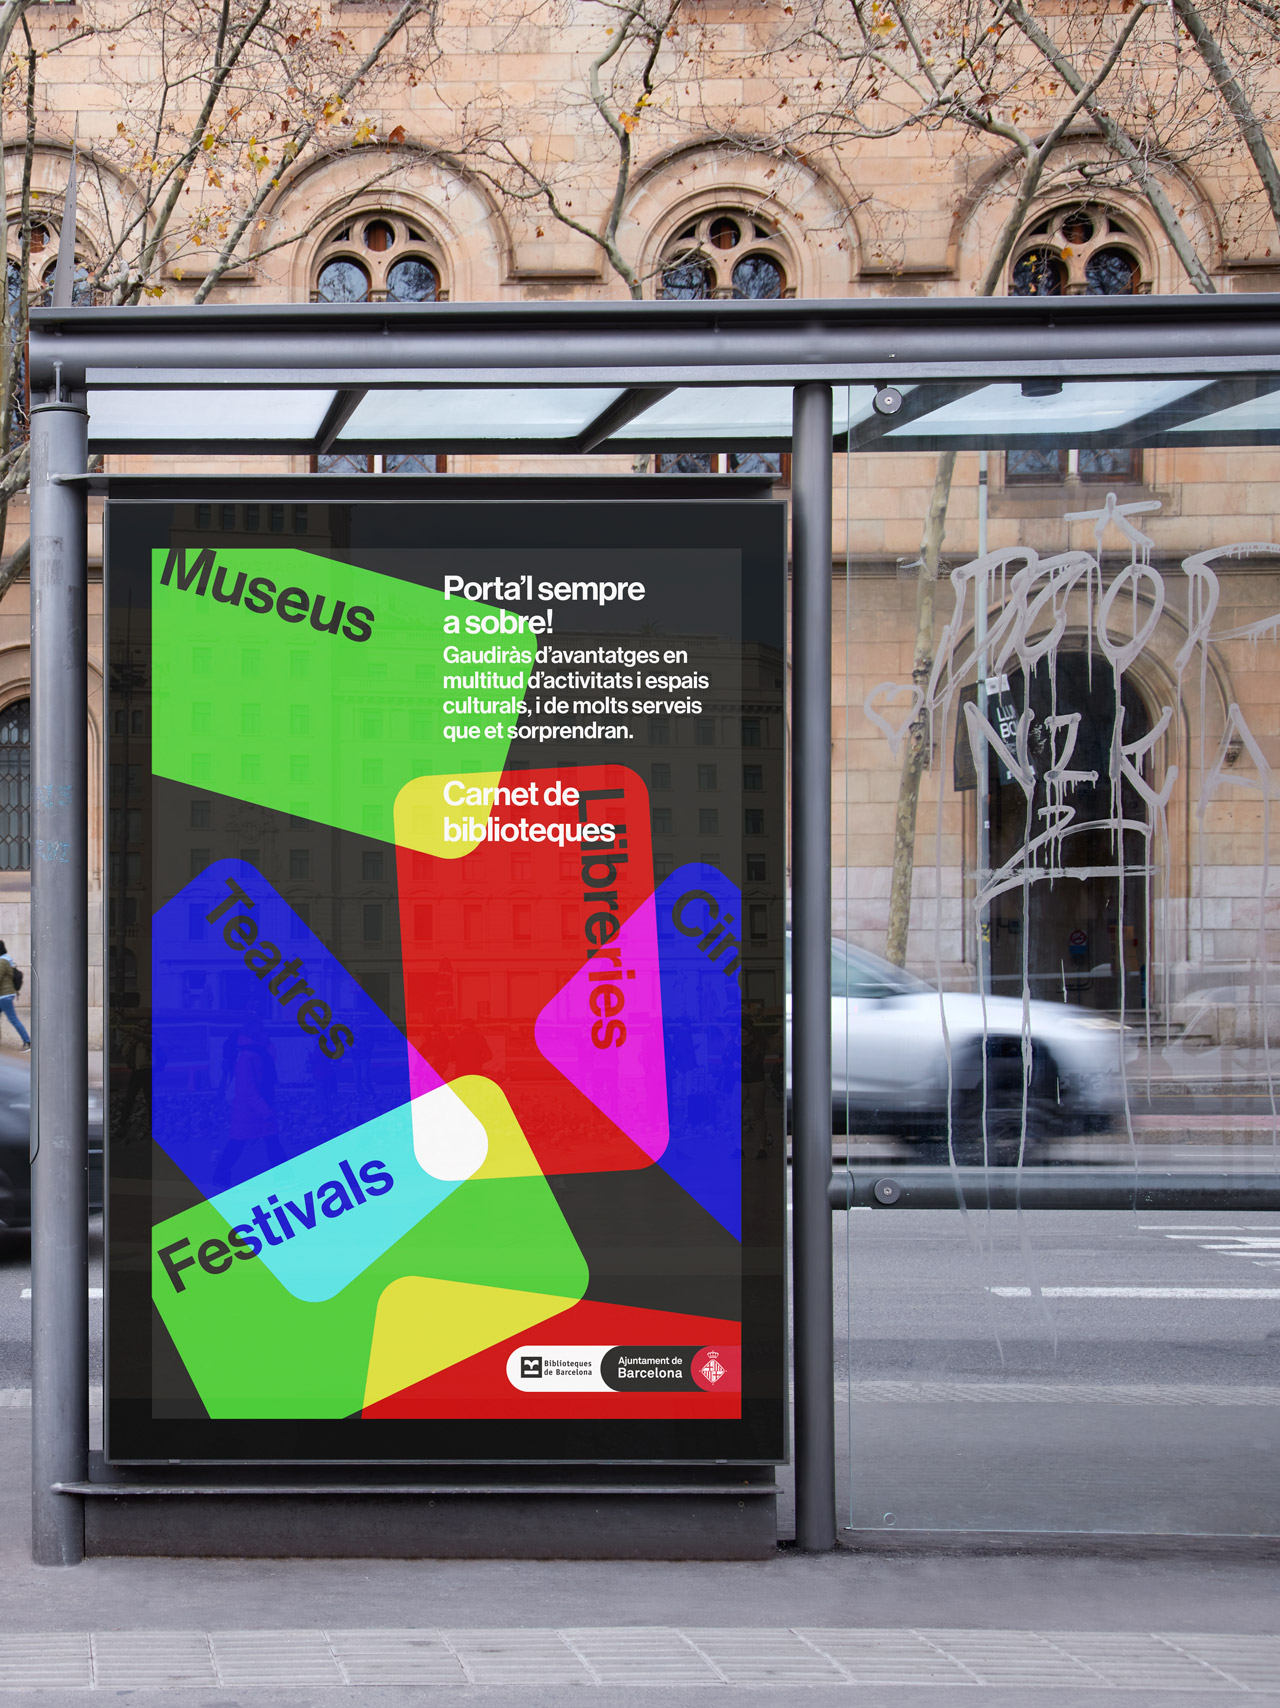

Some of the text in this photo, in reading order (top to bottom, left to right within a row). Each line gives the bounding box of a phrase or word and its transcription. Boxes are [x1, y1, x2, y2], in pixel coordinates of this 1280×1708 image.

[160, 548, 375, 643] Museus
[537, 581, 646, 606] sempre
[443, 608, 553, 635] a sobre!
[443, 645, 533, 664] Gaudiràs
[663, 650, 688, 664] en
[443, 671, 524, 689] multitud
[636, 671, 642, 689] i
[645, 671, 710, 694] espais
[443, 696, 703, 718] culturals, i de molts serveis
[443, 721, 634, 744] que et sorprendran.
[442, 780, 580, 807] Carnet de
[443, 816, 616, 848] biblioteques
[671, 889, 742, 990] Cin
[205, 876, 355, 1060] Teatres
[156, 1159, 395, 1294] Festivals
[543, 1368, 593, 1376] de Barcelona
[544, 1359, 592, 1369] Biblioteques
[617, 1356, 683, 1367] Ajuntament de
[617, 1366, 683, 1379] Barcelona
